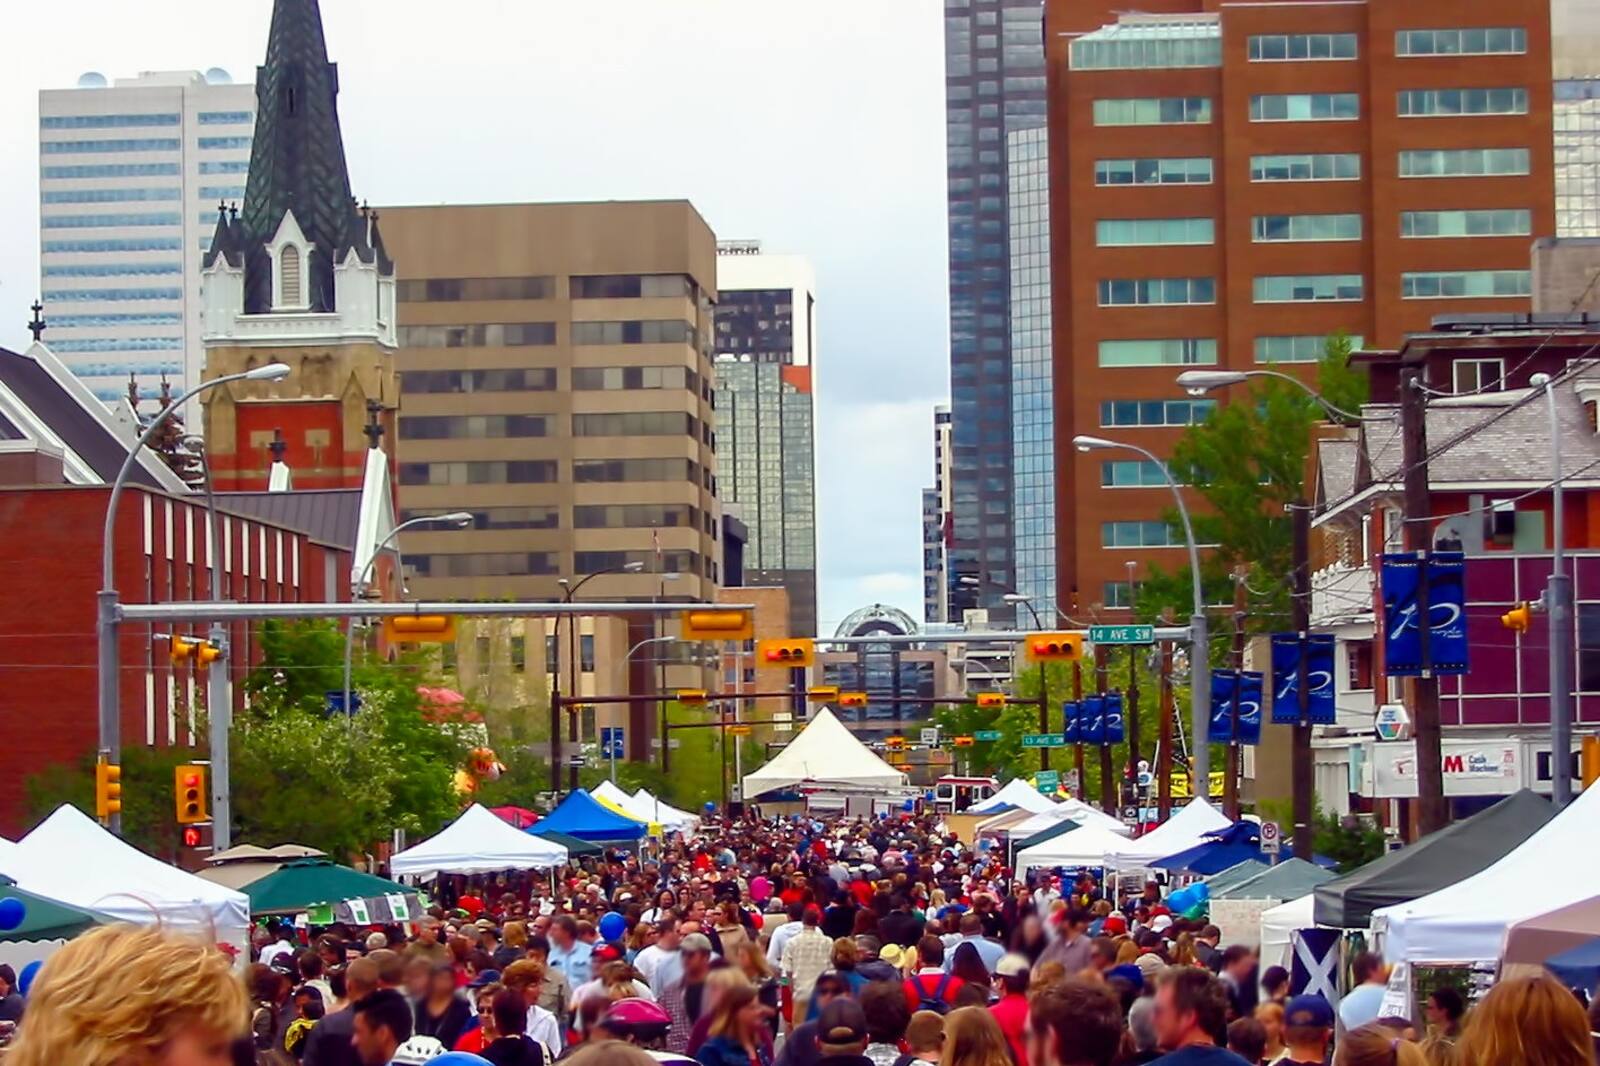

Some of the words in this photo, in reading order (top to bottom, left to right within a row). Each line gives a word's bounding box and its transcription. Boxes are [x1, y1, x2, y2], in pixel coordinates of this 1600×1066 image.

[1092, 629, 1103, 641] 14
[1110, 628, 1129, 640] AVE
[1135, 628, 1150, 640] SW
